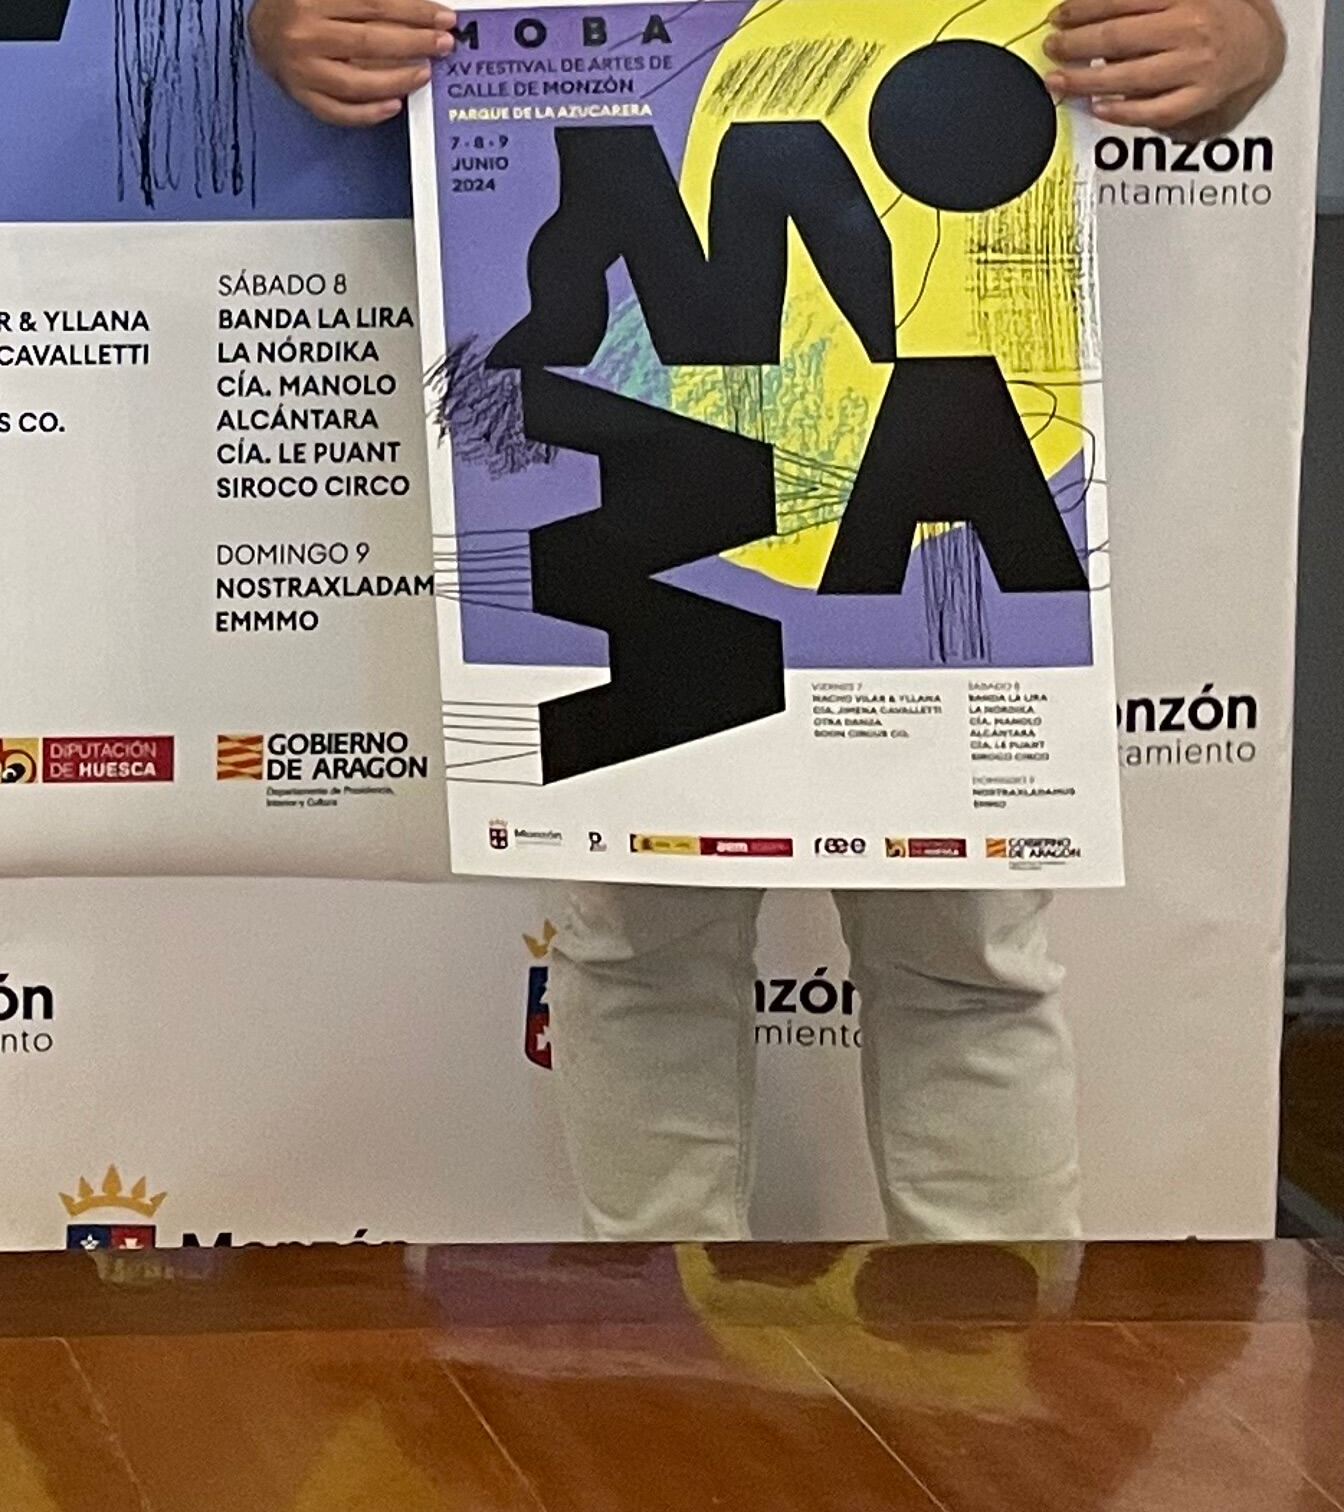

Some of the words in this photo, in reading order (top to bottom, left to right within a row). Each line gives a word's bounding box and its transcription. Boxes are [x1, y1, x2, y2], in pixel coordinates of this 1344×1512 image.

[450, 14, 672, 50] MOBA
[447, 60, 472, 76] XV
[476, 58, 557, 75] FESTIVAL
[561, 57, 584, 73] DE
[588, 55, 645, 72] ARTES
[649, 54, 673, 70] DE
[447, 82, 512, 98] CALLE
[514, 81, 539, 97] DE
[543, 75, 634, 97] MONZÓN
[448, 107, 509, 123] PARQUE
[513, 106, 532, 120] DE
[535, 105, 555, 119] LA
[557, 103, 653, 119] AZUCARERA
[452, 157, 509, 171] JUNIO
[452, 178, 496, 193] 2024
[218, 269, 325, 297] SÁBADO
[332, 273, 347, 296] 8
[18, 310, 37, 332] &
[43, 309, 150, 332] YLLANA
[218, 307, 310, 331] BANDA
[316, 307, 351, 330] LA
[356, 306, 414, 329] LIRA
[218, 341, 251, 364] LA
[256, 334, 379, 363] NÓRDIKA
[217, 370, 272, 398] CÍA.
[279, 374, 397, 397] MANOLO
[17, 412, 65, 435] CO.
[217, 403, 378, 432] ALCÁNTARA
[216, 437, 272, 465] CÍA.
[278, 441, 307, 464] LE
[313, 440, 401, 464] PUANT
[216, 476, 318, 499] SIROCO
[324, 475, 411, 498] CIRCO
[217, 542, 349, 566] DOMINGO
[355, 542, 370, 564] 9
[216, 574, 434, 600] NOSTRAXLADAM
[216, 610, 318, 633] EMMMO
[1117, 683, 1257, 732] nzón
[267, 731, 408, 756] GOBIERNO
[50, 763, 74, 778] DE
[78, 762, 156, 778] HUESCA
[267, 758, 302, 781] DE
[312, 756, 427, 780] ARAGON
